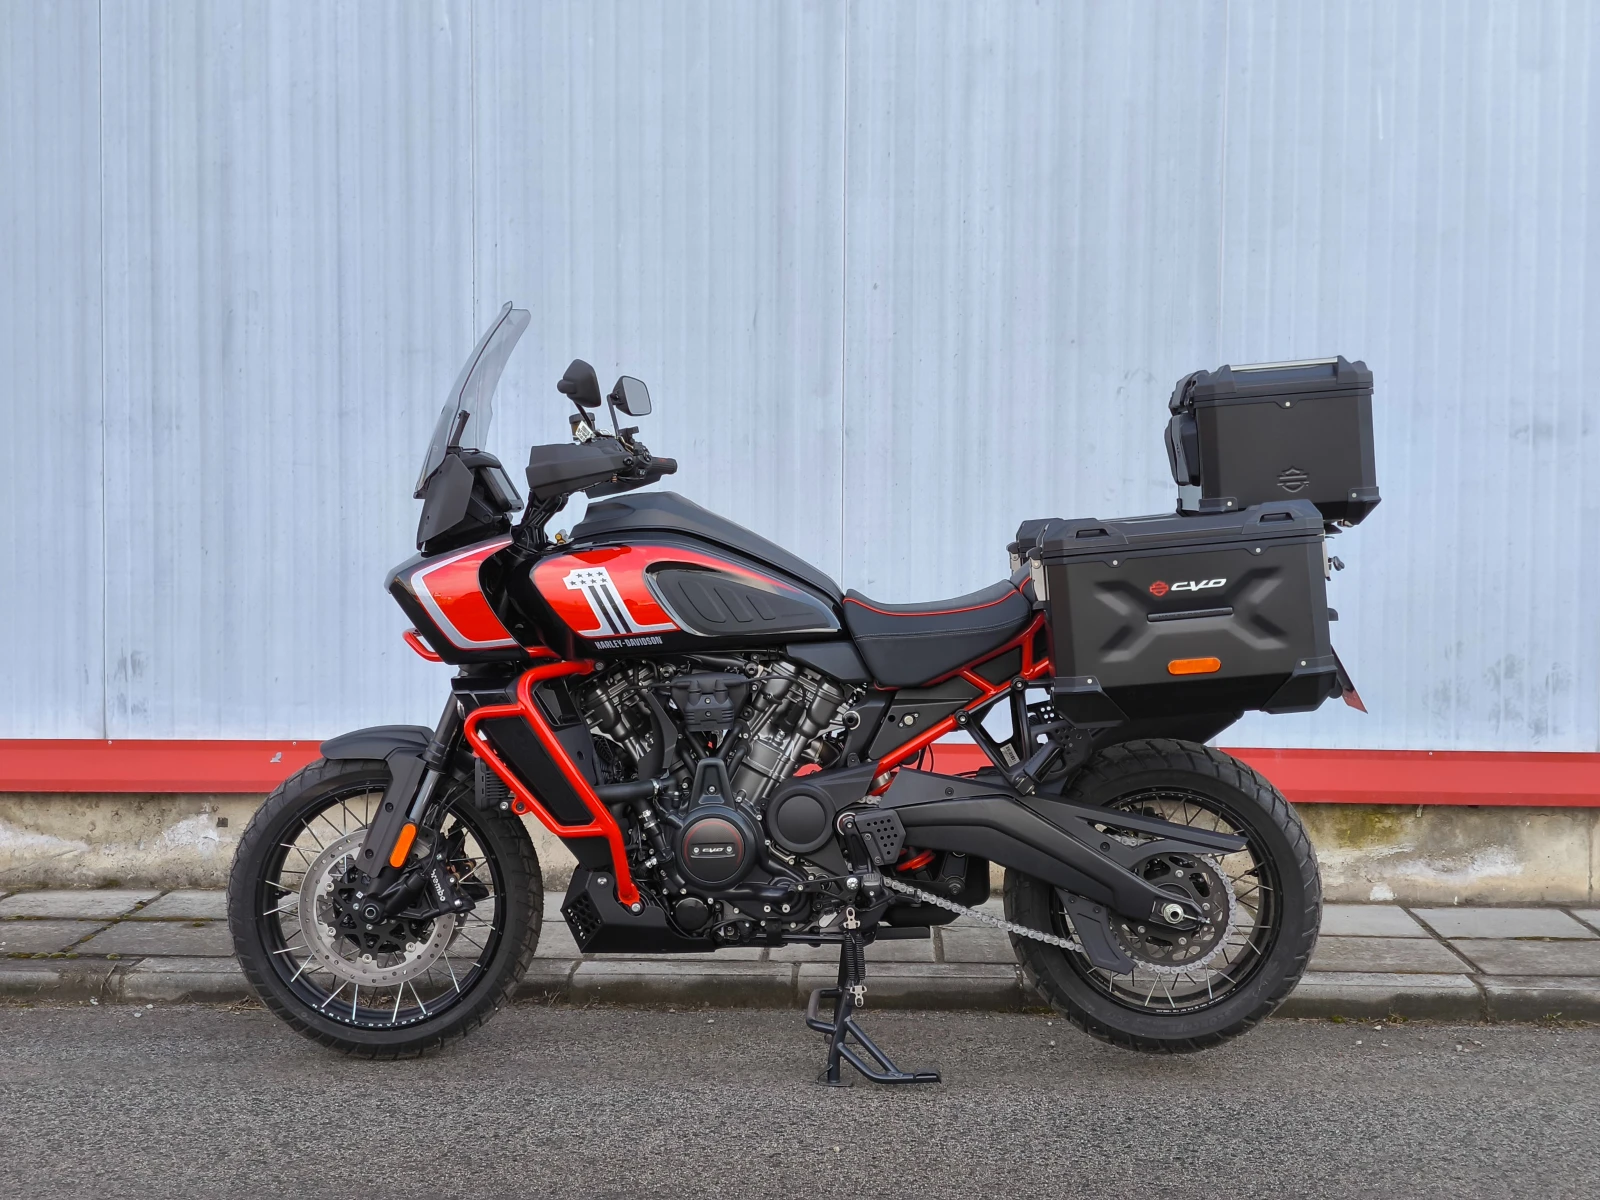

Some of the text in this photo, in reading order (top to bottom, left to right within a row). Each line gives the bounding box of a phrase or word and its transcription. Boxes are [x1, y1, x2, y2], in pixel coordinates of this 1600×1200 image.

[1171, 578, 1227, 591] CVO
[595, 636, 663, 649] HARLEY-DAVIDSON
[430, 868, 446, 902] brembo
